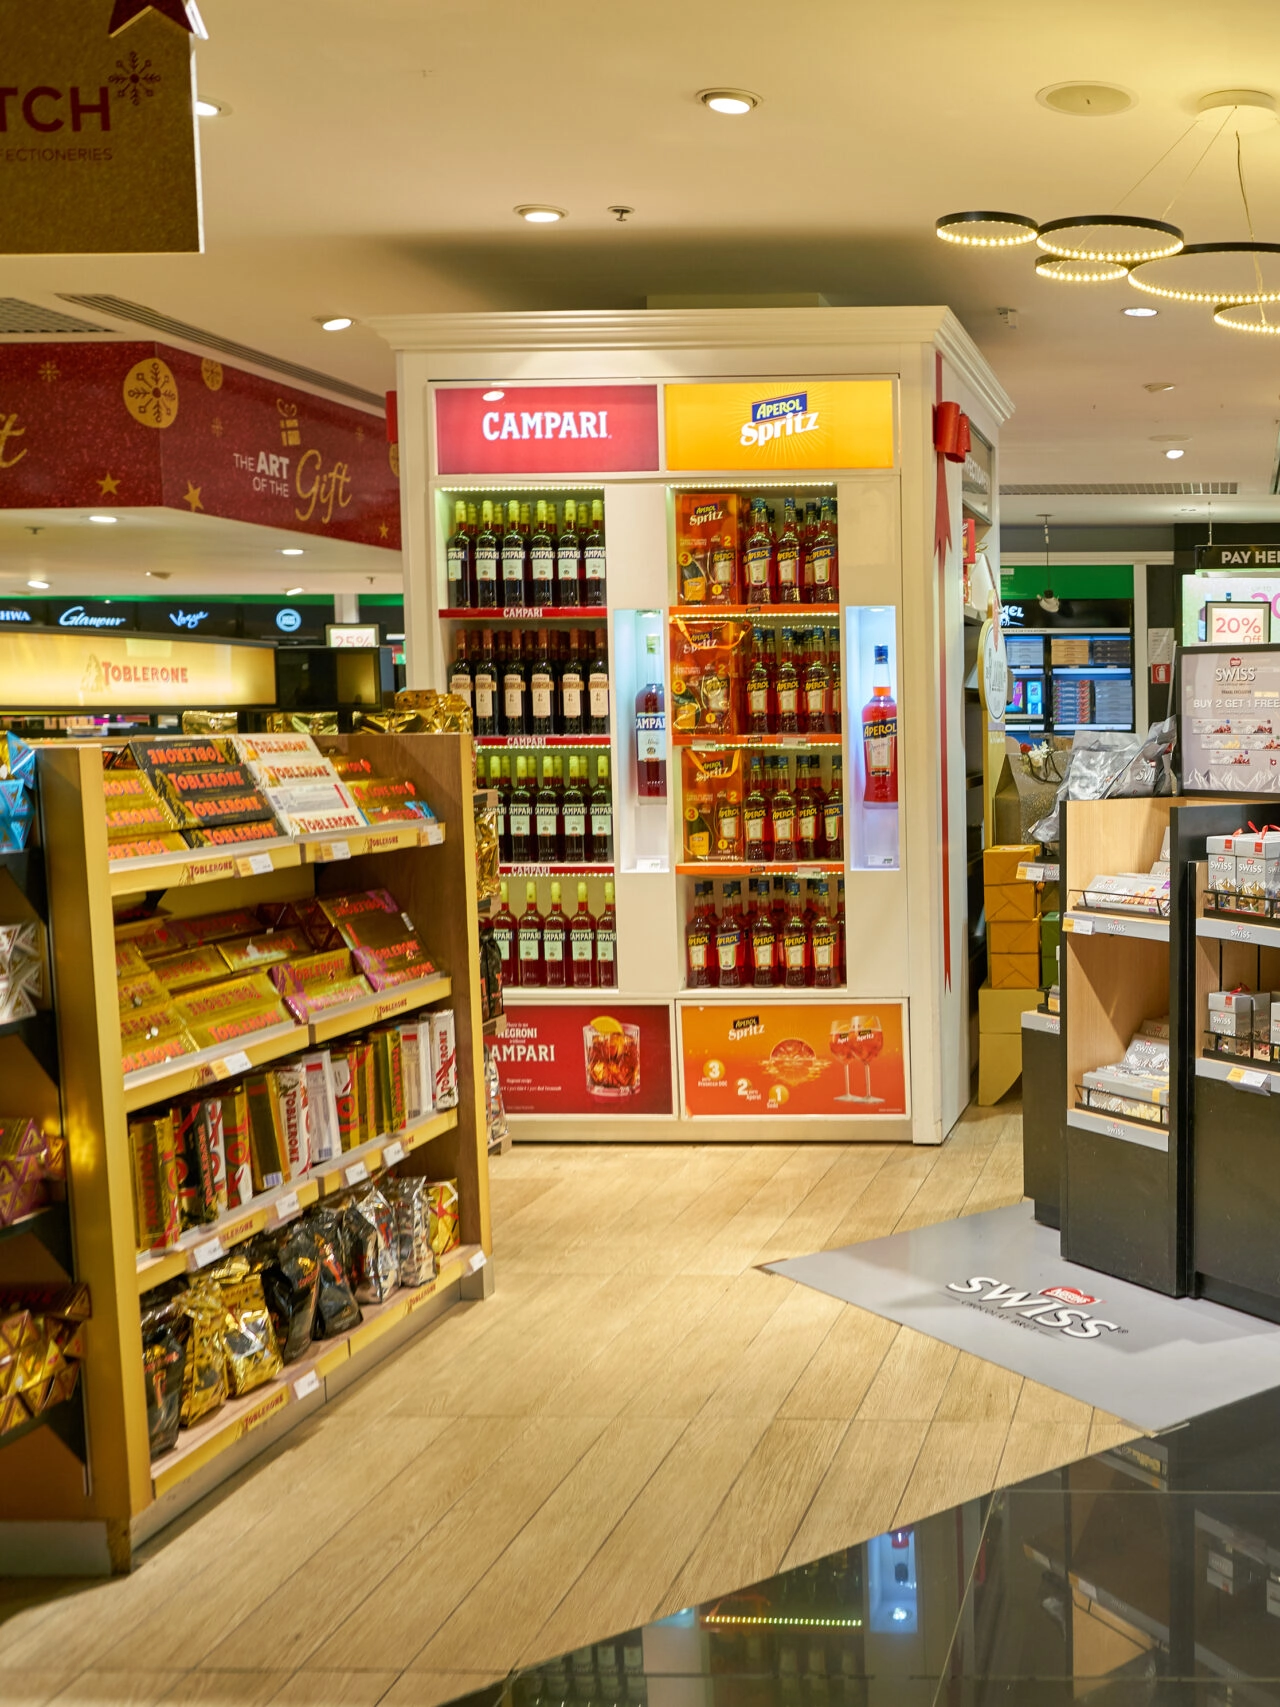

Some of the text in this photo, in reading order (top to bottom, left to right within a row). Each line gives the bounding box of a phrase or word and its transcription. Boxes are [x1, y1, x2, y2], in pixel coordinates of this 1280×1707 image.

[0, 147, 113, 162] ECTIONERIES
[754, 396, 804, 420] APEROL
[482, 411, 609, 440] CAMPARI
[740, 411, 819, 446] Spritz
[233, 451, 290, 480] THE ART
[252, 476, 290, 498] OF THE
[295, 449, 353, 524] Gift
[689, 509, 724, 527] Spritz
[748, 549, 770, 561] APEROL
[776, 550, 799, 561] APEROL
[812, 548, 831, 560] APEROL
[1221, 551, 1251, 564] PAY
[503, 608, 543, 618] CAMPARI
[1000, 605, 1024, 617] MEL
[1216, 617, 1261, 634] 20%
[335, 634, 373, 647] 25%
[102, 661, 188, 686] TOBLERONE
[1215, 667, 1256, 682] SWISS
[747, 681, 769, 692] APEROL
[776, 681, 799, 692] APEROL
[805, 681, 828, 692] APEROL
[1193, 699, 1213, 709] BUY
[1215, 700, 1222, 708] 2
[1225, 699, 1243, 708] GET
[1254, 699, 1280, 708] FREE
[864, 723, 897, 738] APEROL
[246, 739, 308, 754] TOBLERONE
[507, 737, 547, 746] CAMPARI
[147, 745, 225, 765] TOBLERONE
[268, 765, 330, 781] TOBLERONE
[167, 771, 245, 793] TOBLERONE
[184, 796, 262, 819] TOBLERONE
[745, 807, 766, 819] APEROL
[773, 807, 795, 819] APEROL
[106, 806, 164, 828] LERONE
[299, 815, 360, 832] TOBLERONE
[203, 823, 278, 847] TOBLERONE
[369, 835, 399, 849] TOBLERONE
[190, 860, 233, 877] TOBLERONE
[1210, 860, 1233, 871] SWISS
[1238, 864, 1262, 874] SWISS
[688, 935, 709, 947] APEROL
[716, 935, 738, 947] APEROL
[753, 935, 775, 947] APEROL
[785, 935, 806, 947] APEROL
[813, 935, 835, 947] APEROL
[1230, 929, 1251, 940] SWISS
[208, 1009, 283, 1044] TOBLERONE
[1213, 1016, 1232, 1025] SWISS
[498, 1028, 537, 1039] NEGRONI
[728, 1023, 765, 1041] Spritz
[122, 1039, 185, 1073] BLERONE
[491, 1044, 555, 1062] AMPARI
[1135, 1043, 1157, 1055] SWISS
[709, 1064, 720, 1079] 3
[738, 1080, 748, 1096] 2
[285, 1090, 300, 1164] TOBLERONE
[946, 1276, 1120, 1339] SWISS
